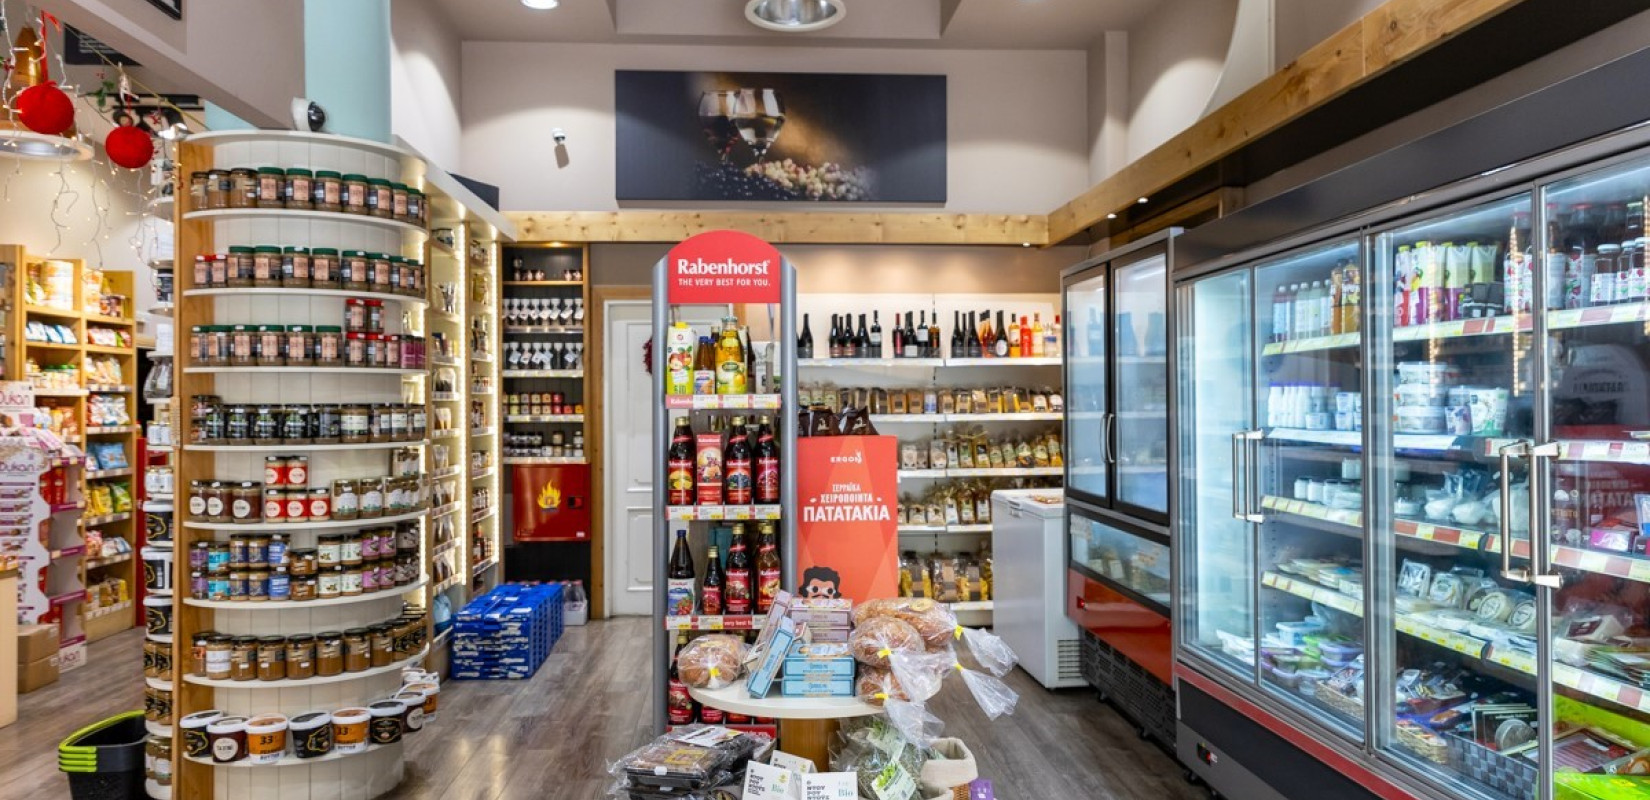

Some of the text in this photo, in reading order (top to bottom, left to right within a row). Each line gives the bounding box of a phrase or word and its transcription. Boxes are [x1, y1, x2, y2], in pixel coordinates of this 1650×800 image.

[677, 257, 770, 275] Rabenhorst
[678, 278, 771, 287] THE VERY BEST FOR YOU.
[820, 493, 873, 504] ΧΕΙΡΟΠΟΙΗΤΑ
[803, 504, 890, 522] ΠΑΤΑΤΑΚΙΑ
